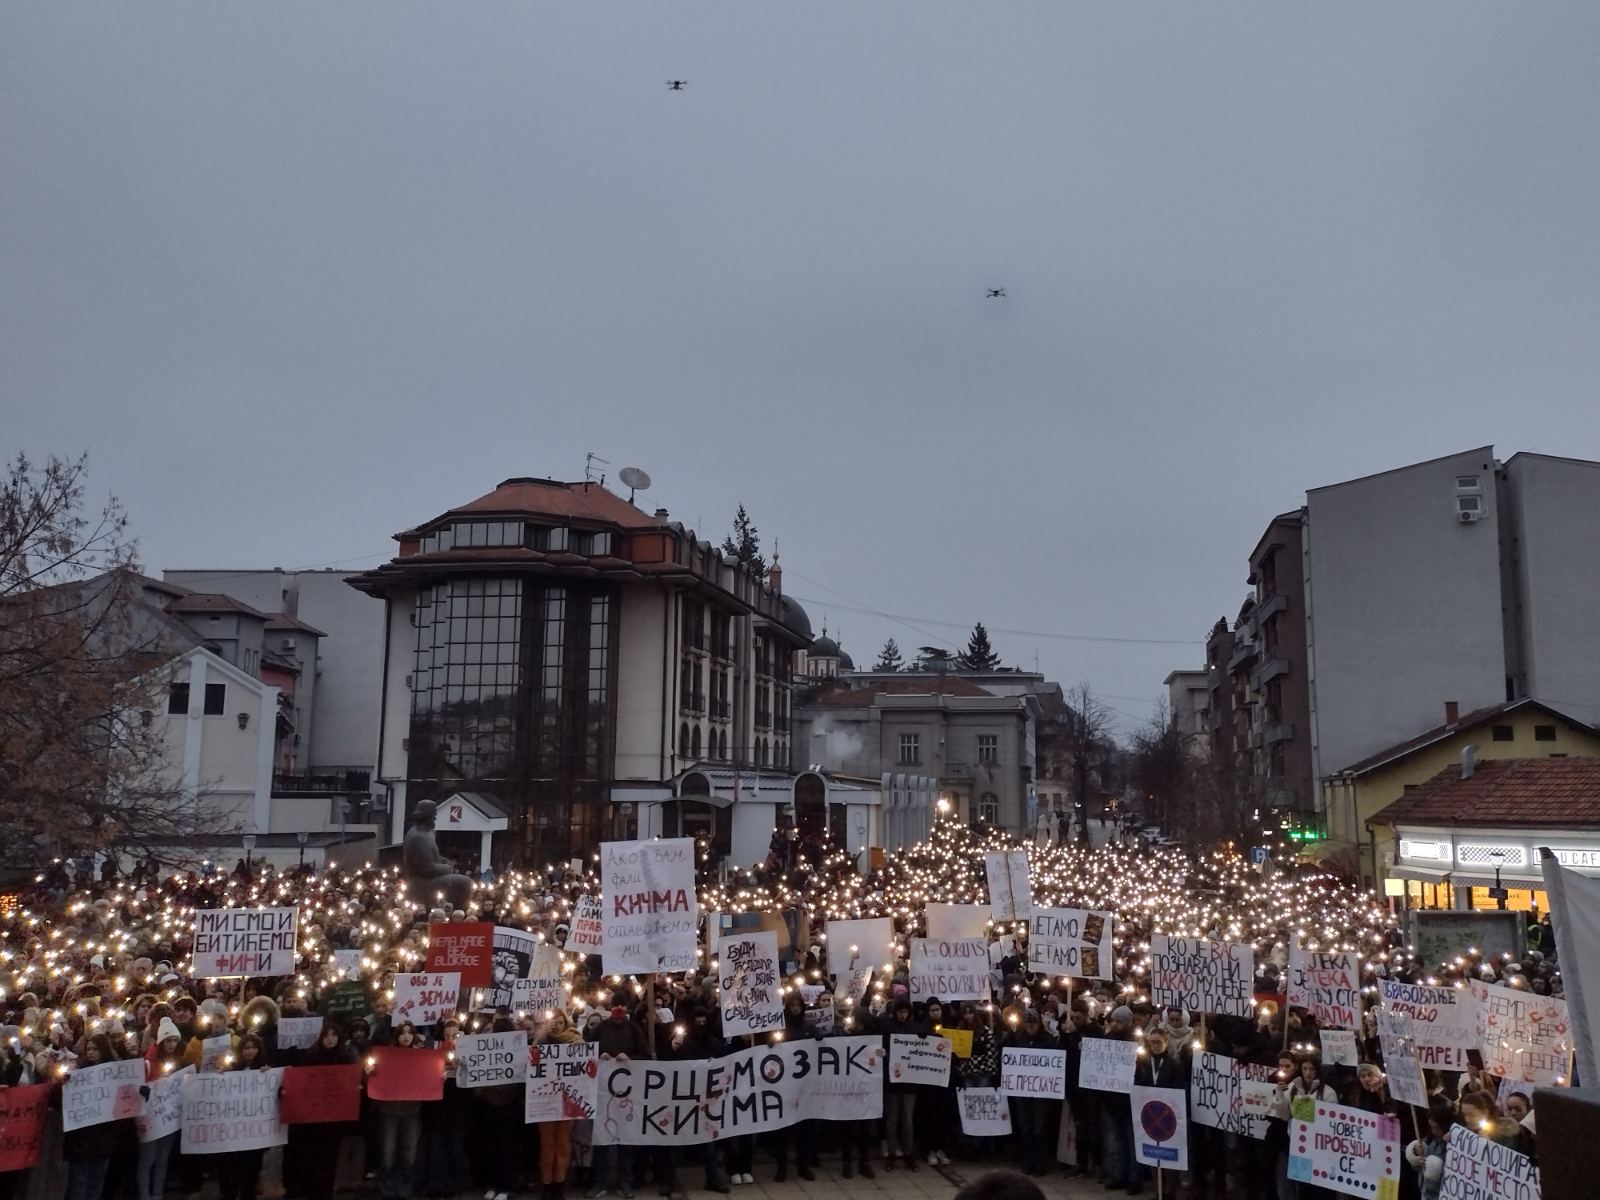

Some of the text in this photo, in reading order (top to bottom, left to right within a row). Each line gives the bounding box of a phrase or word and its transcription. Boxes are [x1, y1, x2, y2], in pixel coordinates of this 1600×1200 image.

[614, 889, 689, 917] КИЧМА
[201, 912, 292, 932] МИ СМО И
[1168, 937, 1239, 961] КО ЈЕ ВАС
[1153, 954, 1240, 980] ПОЗНАВАО НИ
[1154, 972, 1193, 992] ПАКАО
[1216, 978, 1248, 999] НЕЋЕ
[1155, 988, 1252, 1019] ТЕШКО ПАСТИ
[477, 1039, 505, 1051] DUM
[469, 1052, 513, 1067] SPIRO
[530, 1063, 546, 1078] ЈЕ
[732, 1044, 873, 1091] МОЗАК
[469, 1067, 514, 1082] SPERO
[641, 1090, 783, 1136] КИЧМА
[1329, 1121, 1364, 1140] ЧОВЕЧЕ
[1450, 1126, 1479, 1157] САМО
[1315, 1133, 1371, 1159] ПРОБУДИ
[1339, 1156, 1356, 1174] СЕ
